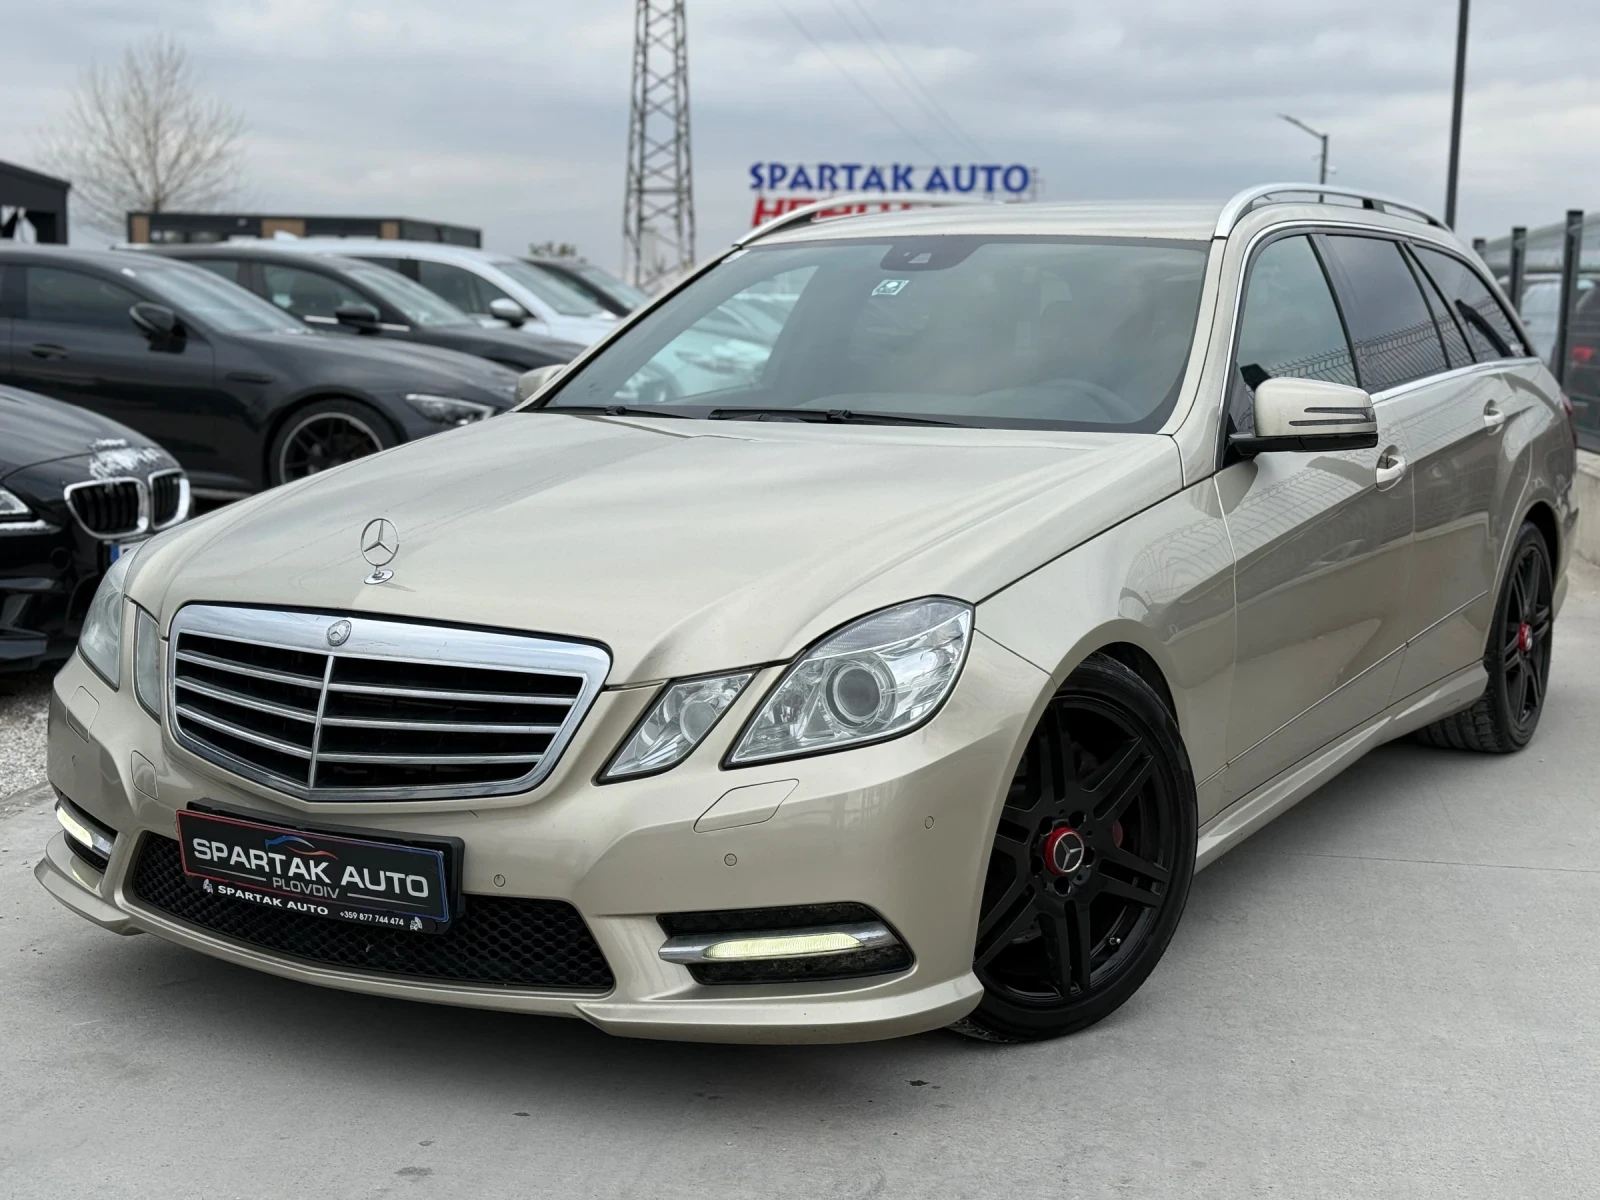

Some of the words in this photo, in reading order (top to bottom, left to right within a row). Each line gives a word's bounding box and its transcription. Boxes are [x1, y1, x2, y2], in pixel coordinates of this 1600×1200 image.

[749, 162, 913, 193] SPARTAK
[924, 163, 1030, 193] AUTO
[192, 838, 332, 883] SPARTAK
[341, 865, 429, 898] AUTO
[217, 885, 283, 907] SPARTAK
[287, 901, 329, 915] AUTO
[272, 876, 340, 899] PLOVDIV
[340, 910, 358, 920] +359
[359, 912, 373, 922] 877
[374, 914, 389, 924] 744
[389, 917, 404, 926] 474
